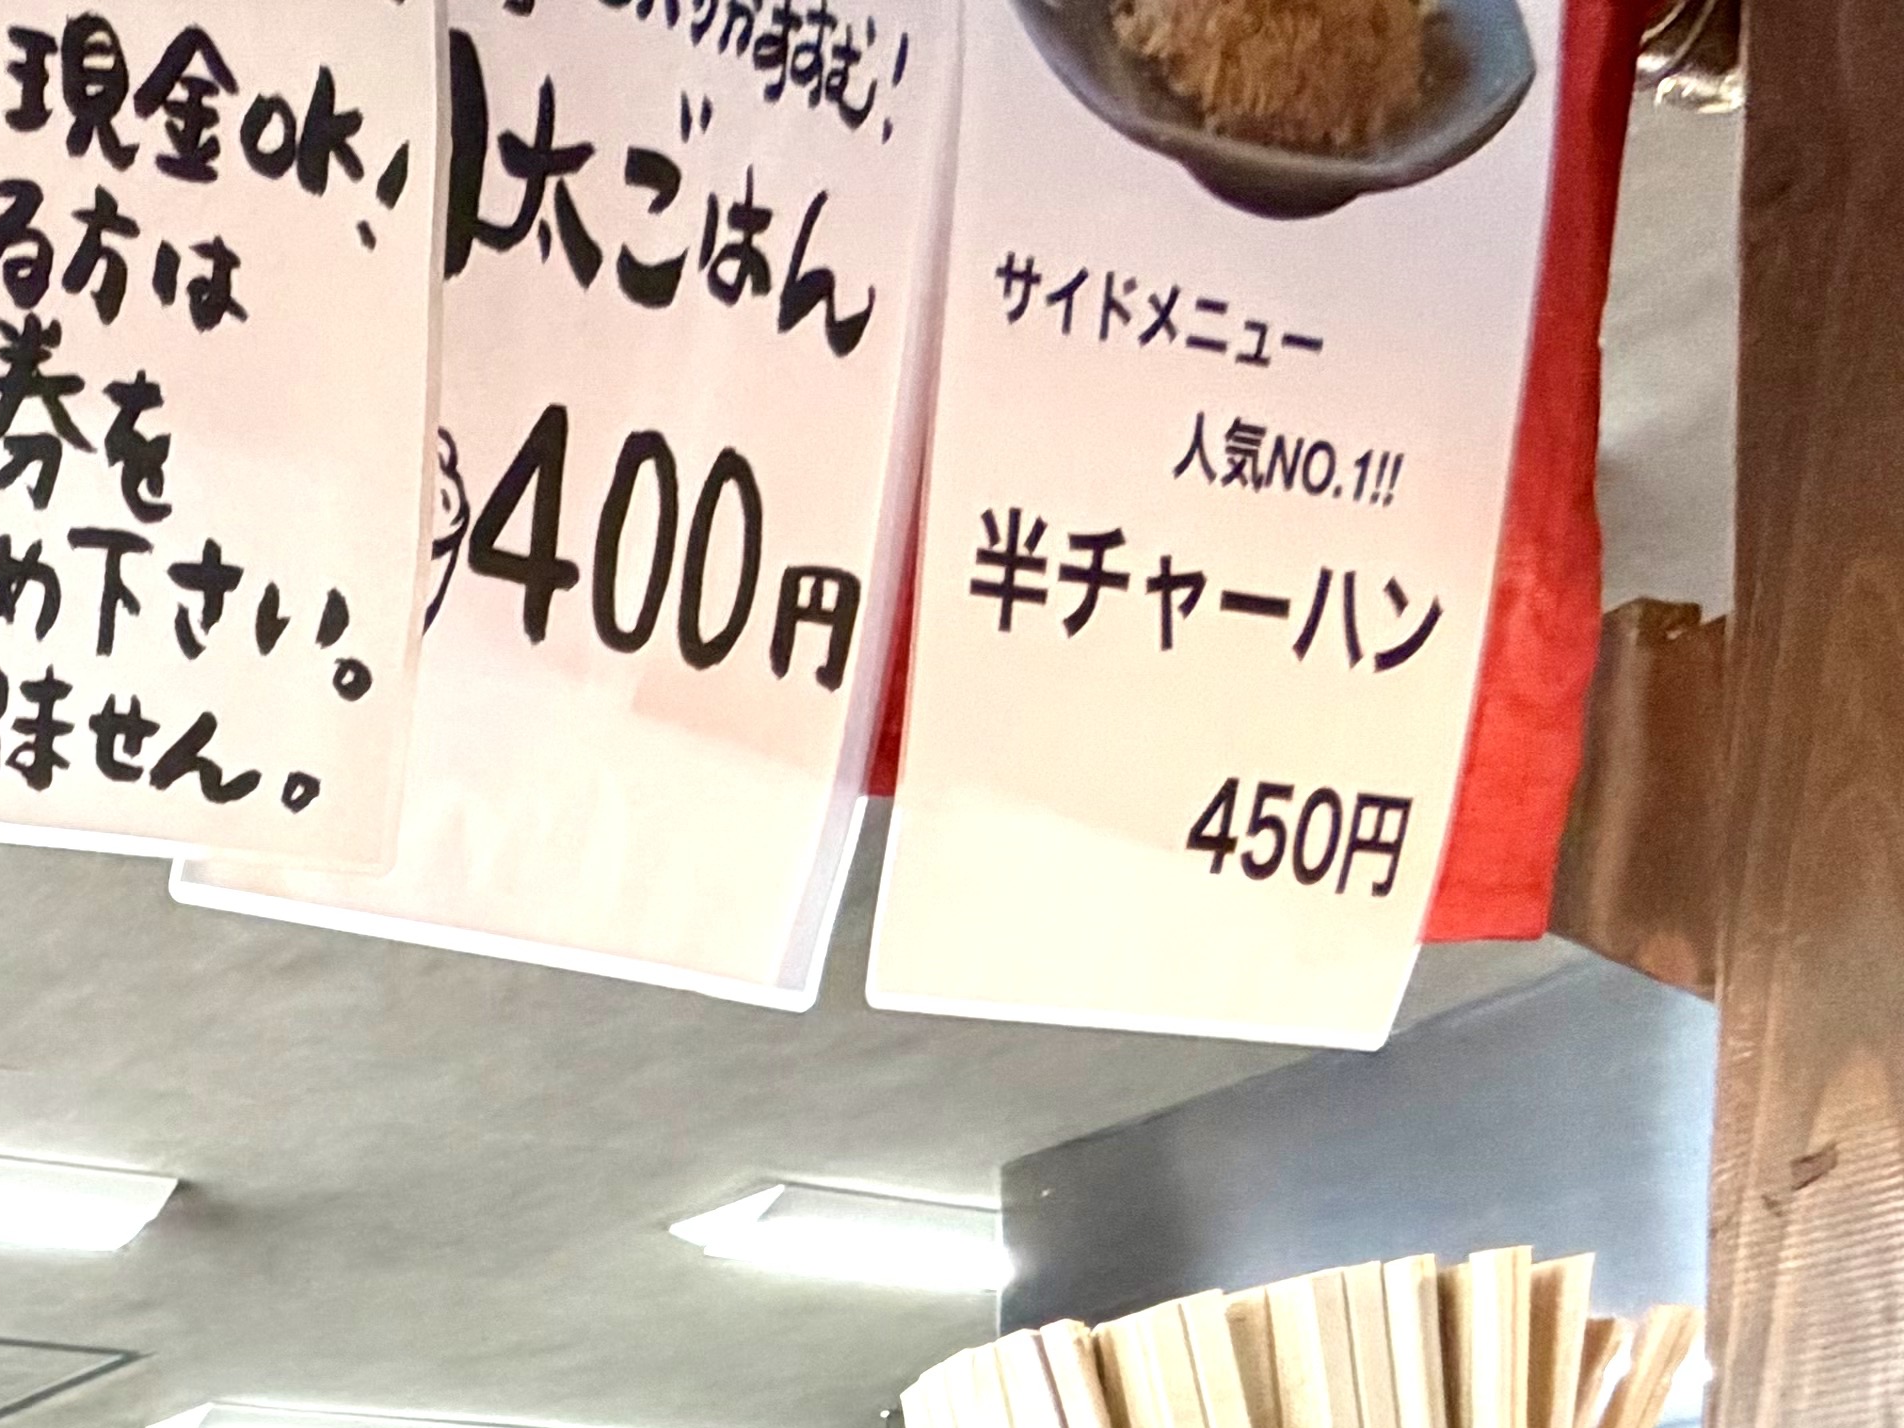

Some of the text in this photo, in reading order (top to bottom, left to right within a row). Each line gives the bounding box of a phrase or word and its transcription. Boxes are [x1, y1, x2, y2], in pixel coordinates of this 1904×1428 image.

[445, 27, 876, 357] 太ごはん
[995, 251, 1323, 368] サイドメニュー
[1173, 411, 1404, 506] 人気NO.1!!
[468, 405, 862, 690] 400円
[970, 507, 1443, 673] 半チャーハン
[1186, 777, 1413, 898] 450円
